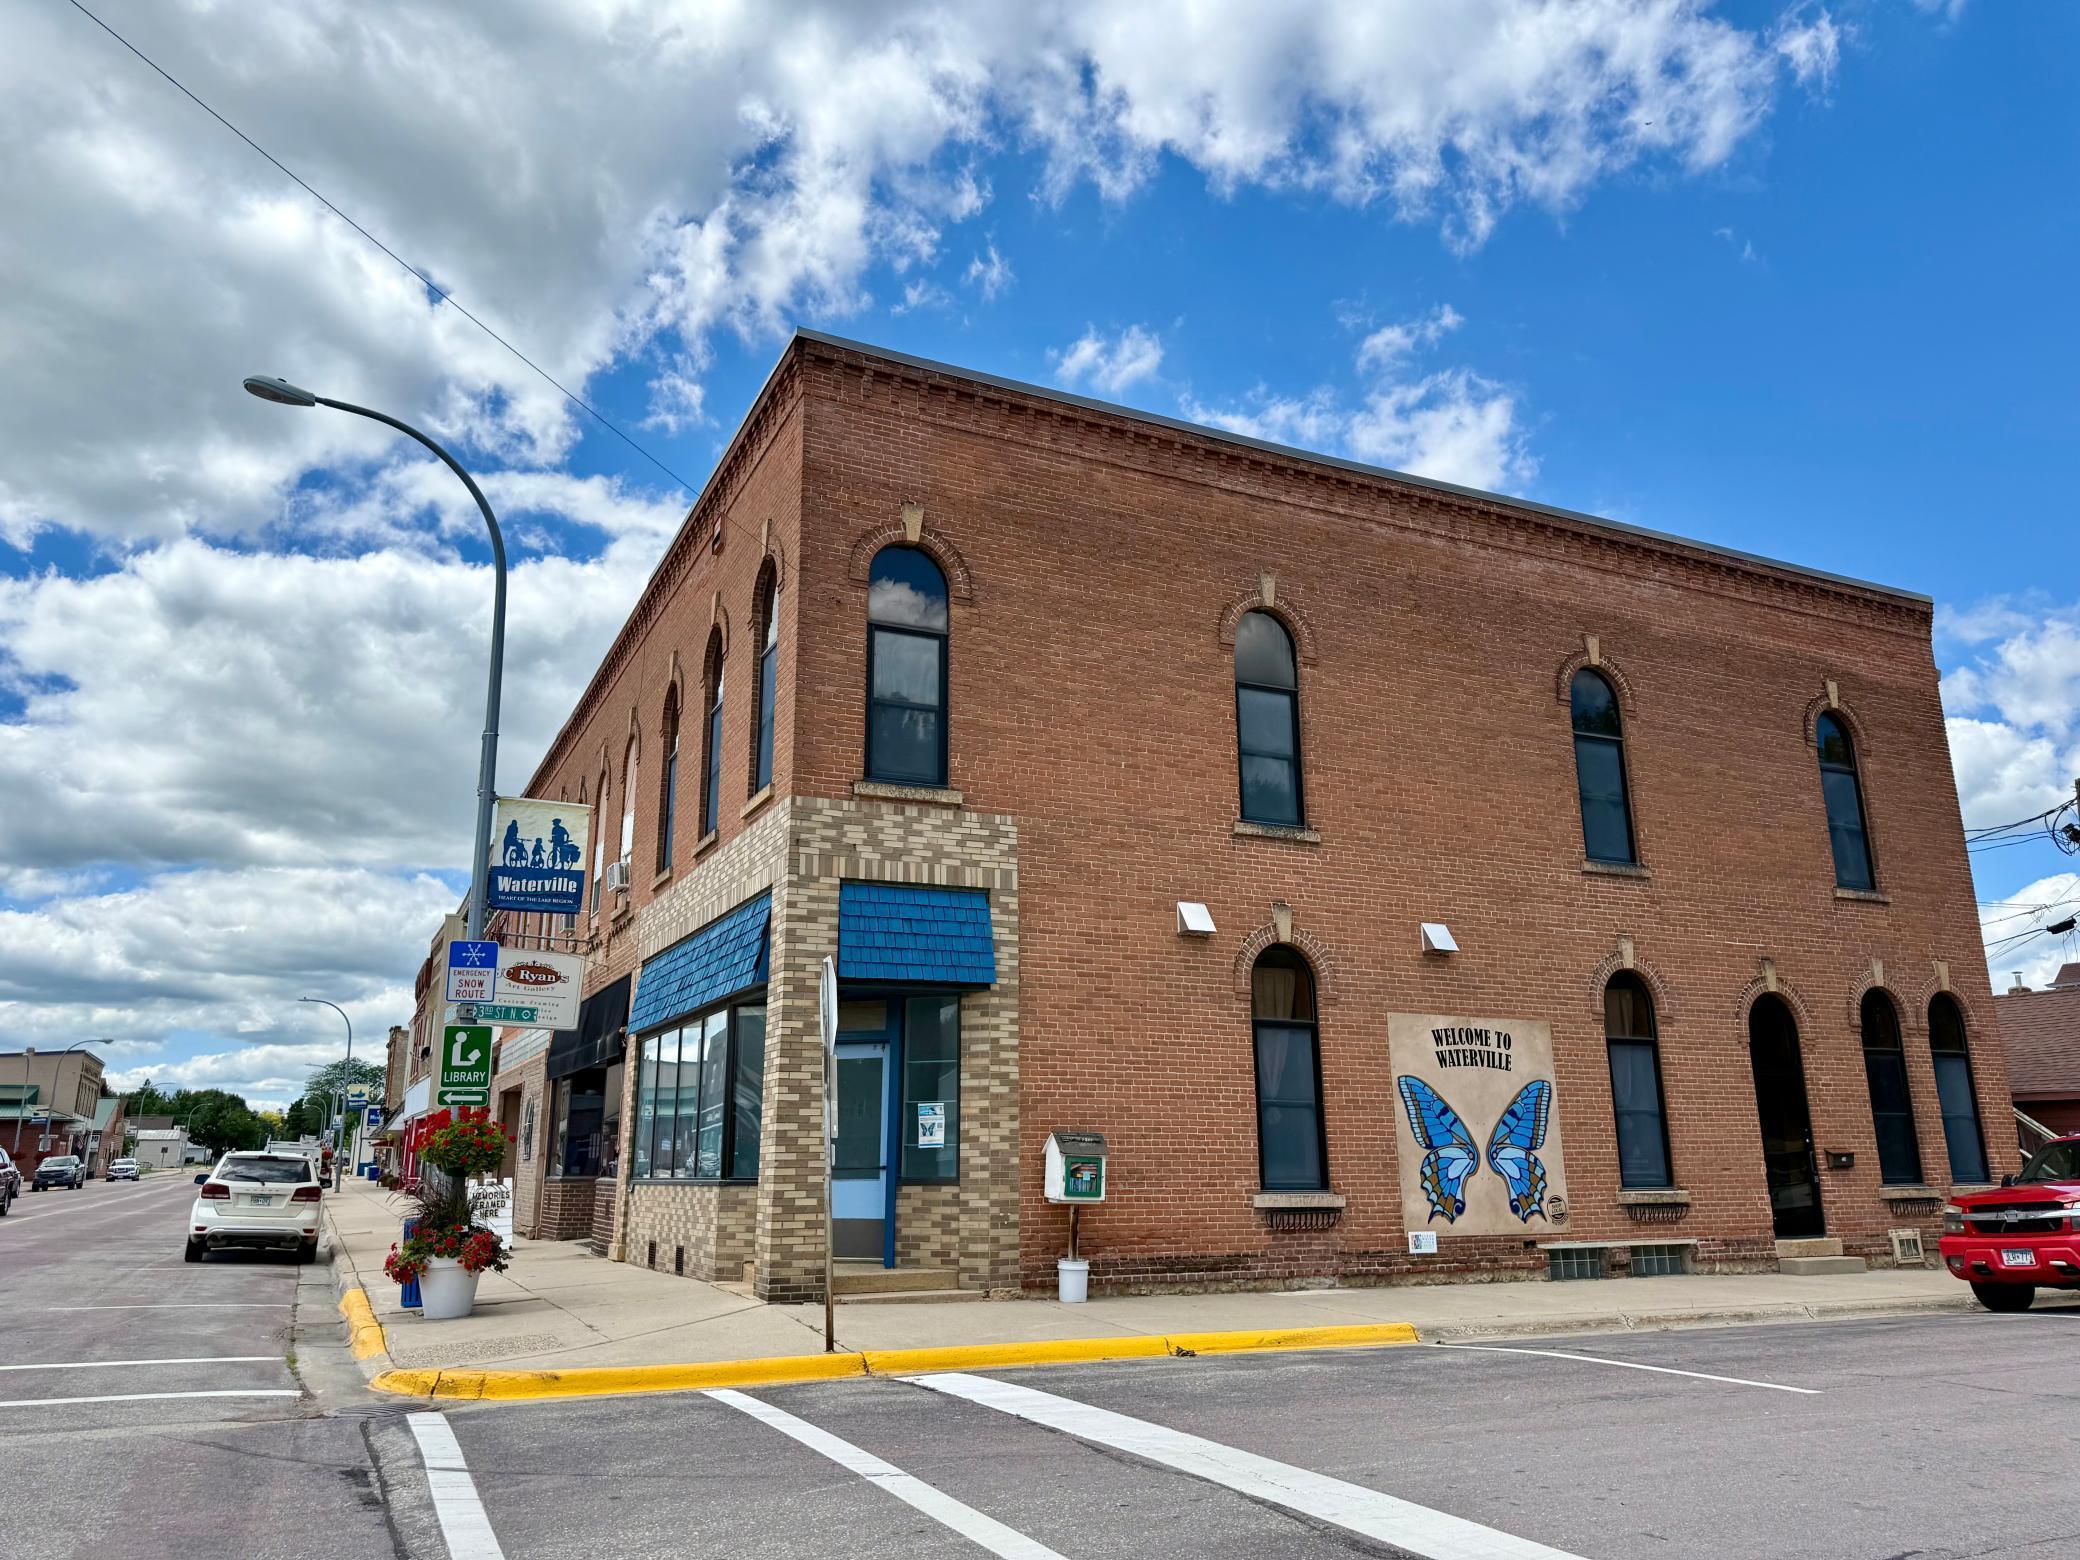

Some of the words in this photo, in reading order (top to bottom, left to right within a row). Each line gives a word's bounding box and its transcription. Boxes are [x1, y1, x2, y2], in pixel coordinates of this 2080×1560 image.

[497, 875, 577, 893] Waterville
[453, 969, 490, 977] EMERGENCY
[519, 969, 570, 984] Ryan's
[458, 978, 485, 988] SNOW
[505, 982, 520, 990] Art
[455, 989, 486, 999] ROUTE
[494, 1006, 506, 1019] ST
[1431, 1027, 1491, 1047] WELCOME
[1494, 1030, 1512, 1051] TO
[1435, 1048, 1512, 1072] WATERVILLE
[444, 1071, 486, 1083] LIBRARY
[472, 1191, 510, 1200] MEMORIES
